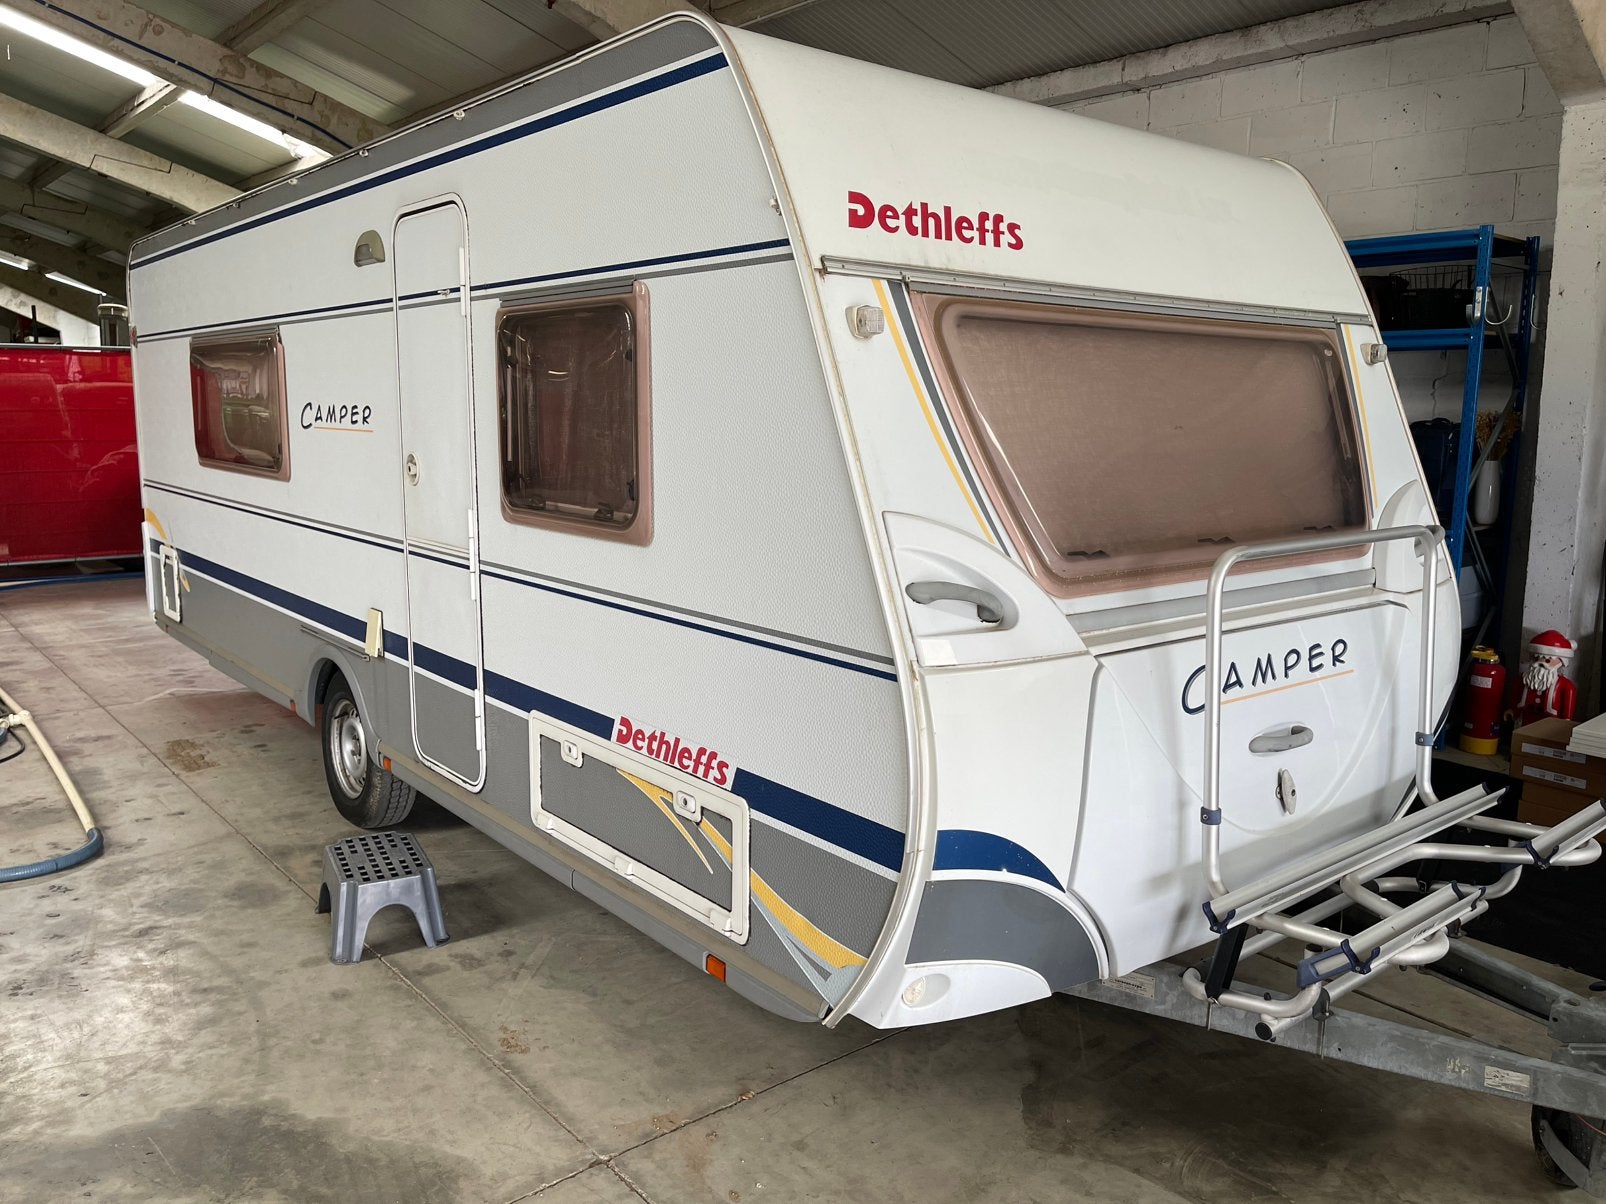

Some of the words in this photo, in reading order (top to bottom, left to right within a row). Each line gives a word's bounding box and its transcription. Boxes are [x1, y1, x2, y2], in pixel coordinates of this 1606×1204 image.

[848, 191, 1024, 251] Dethleffs
[301, 402, 372, 430] CAMPER
[1182, 638, 1348, 715] CAMPER
[616, 716, 730, 785] Dethleffs
